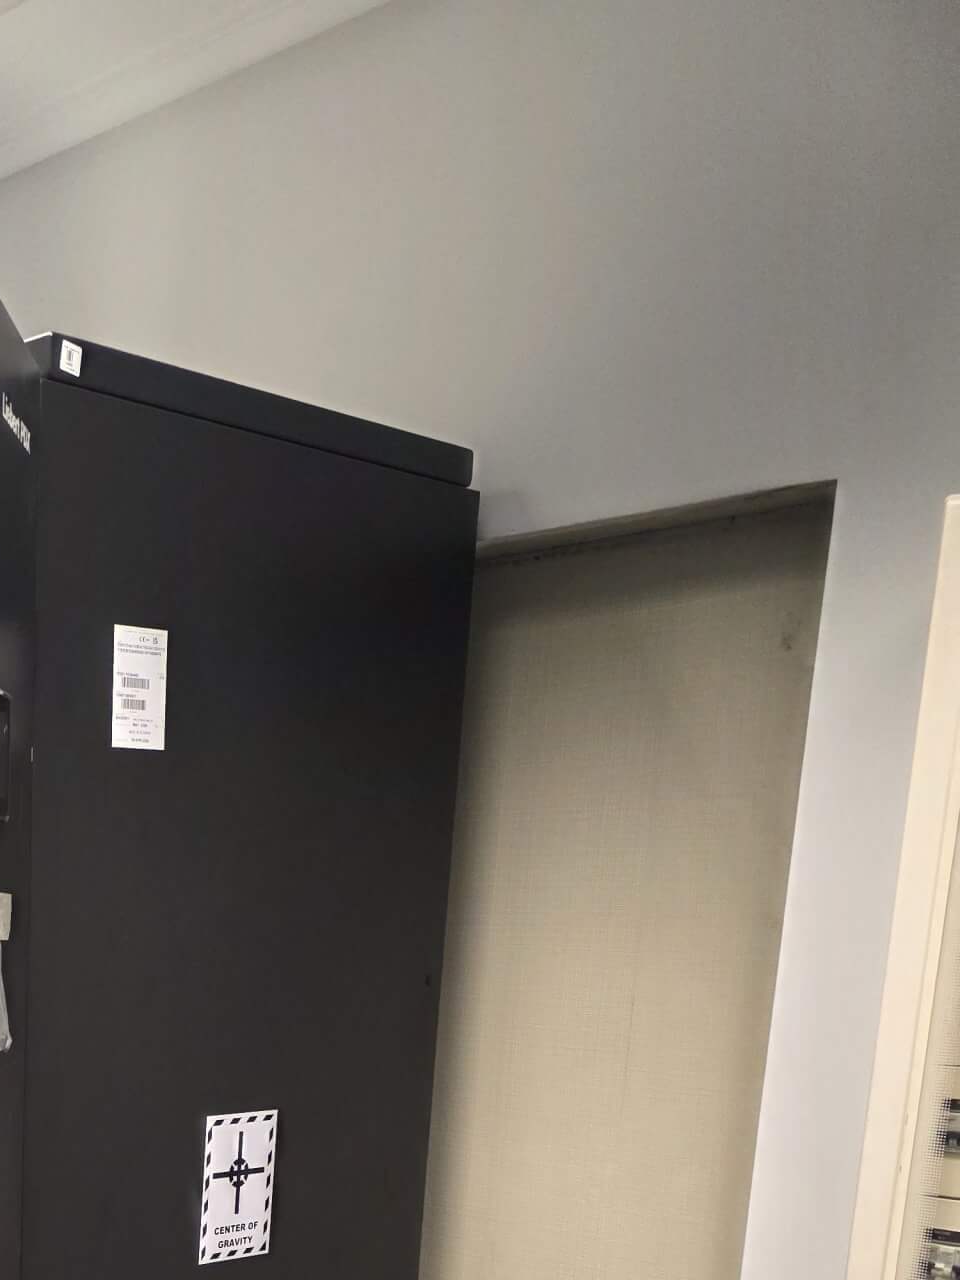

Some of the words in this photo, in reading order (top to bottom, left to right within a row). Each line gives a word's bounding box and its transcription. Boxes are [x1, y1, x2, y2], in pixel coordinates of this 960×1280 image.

[2, 391, 20, 440] Liebert
[214, 1223, 246, 1236] CENTER
[247, 1220, 259, 1231] OF
[217, 1235, 253, 1249] GRAVITY
